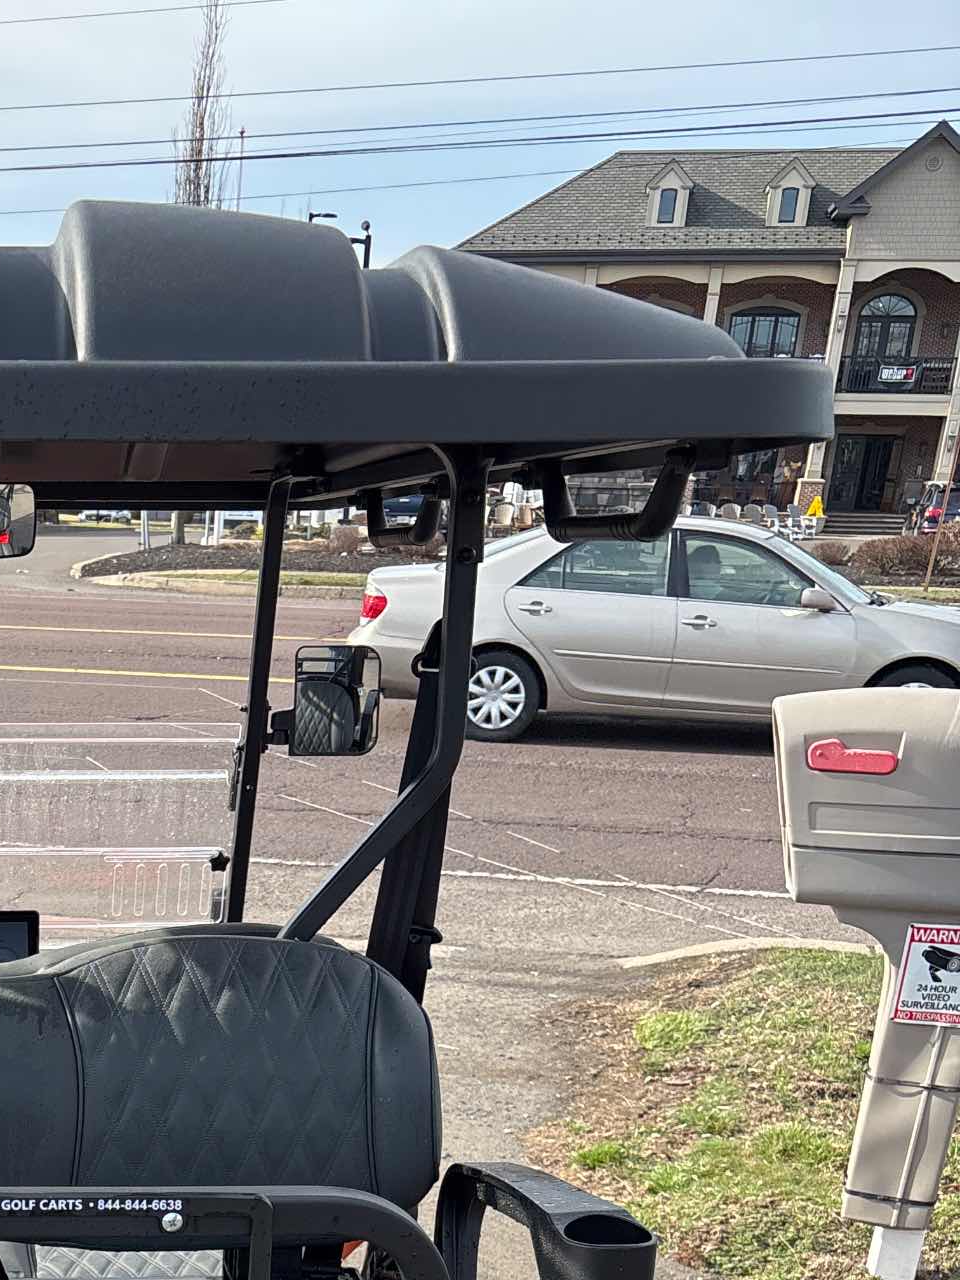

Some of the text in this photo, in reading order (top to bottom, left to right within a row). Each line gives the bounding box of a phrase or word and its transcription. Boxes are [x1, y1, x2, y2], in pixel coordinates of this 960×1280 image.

[913, 928, 960, 943] WARN
[917, 984, 958, 994] 24 HOUR
[922, 993, 951, 1002] VIDEO
[897, 1011, 911, 1019] NO
[1, 1199, 36, 1211] GOLF
[40, 1199, 83, 1210] CARTS
[97, 1199, 182, 1211] 844-844-6638
